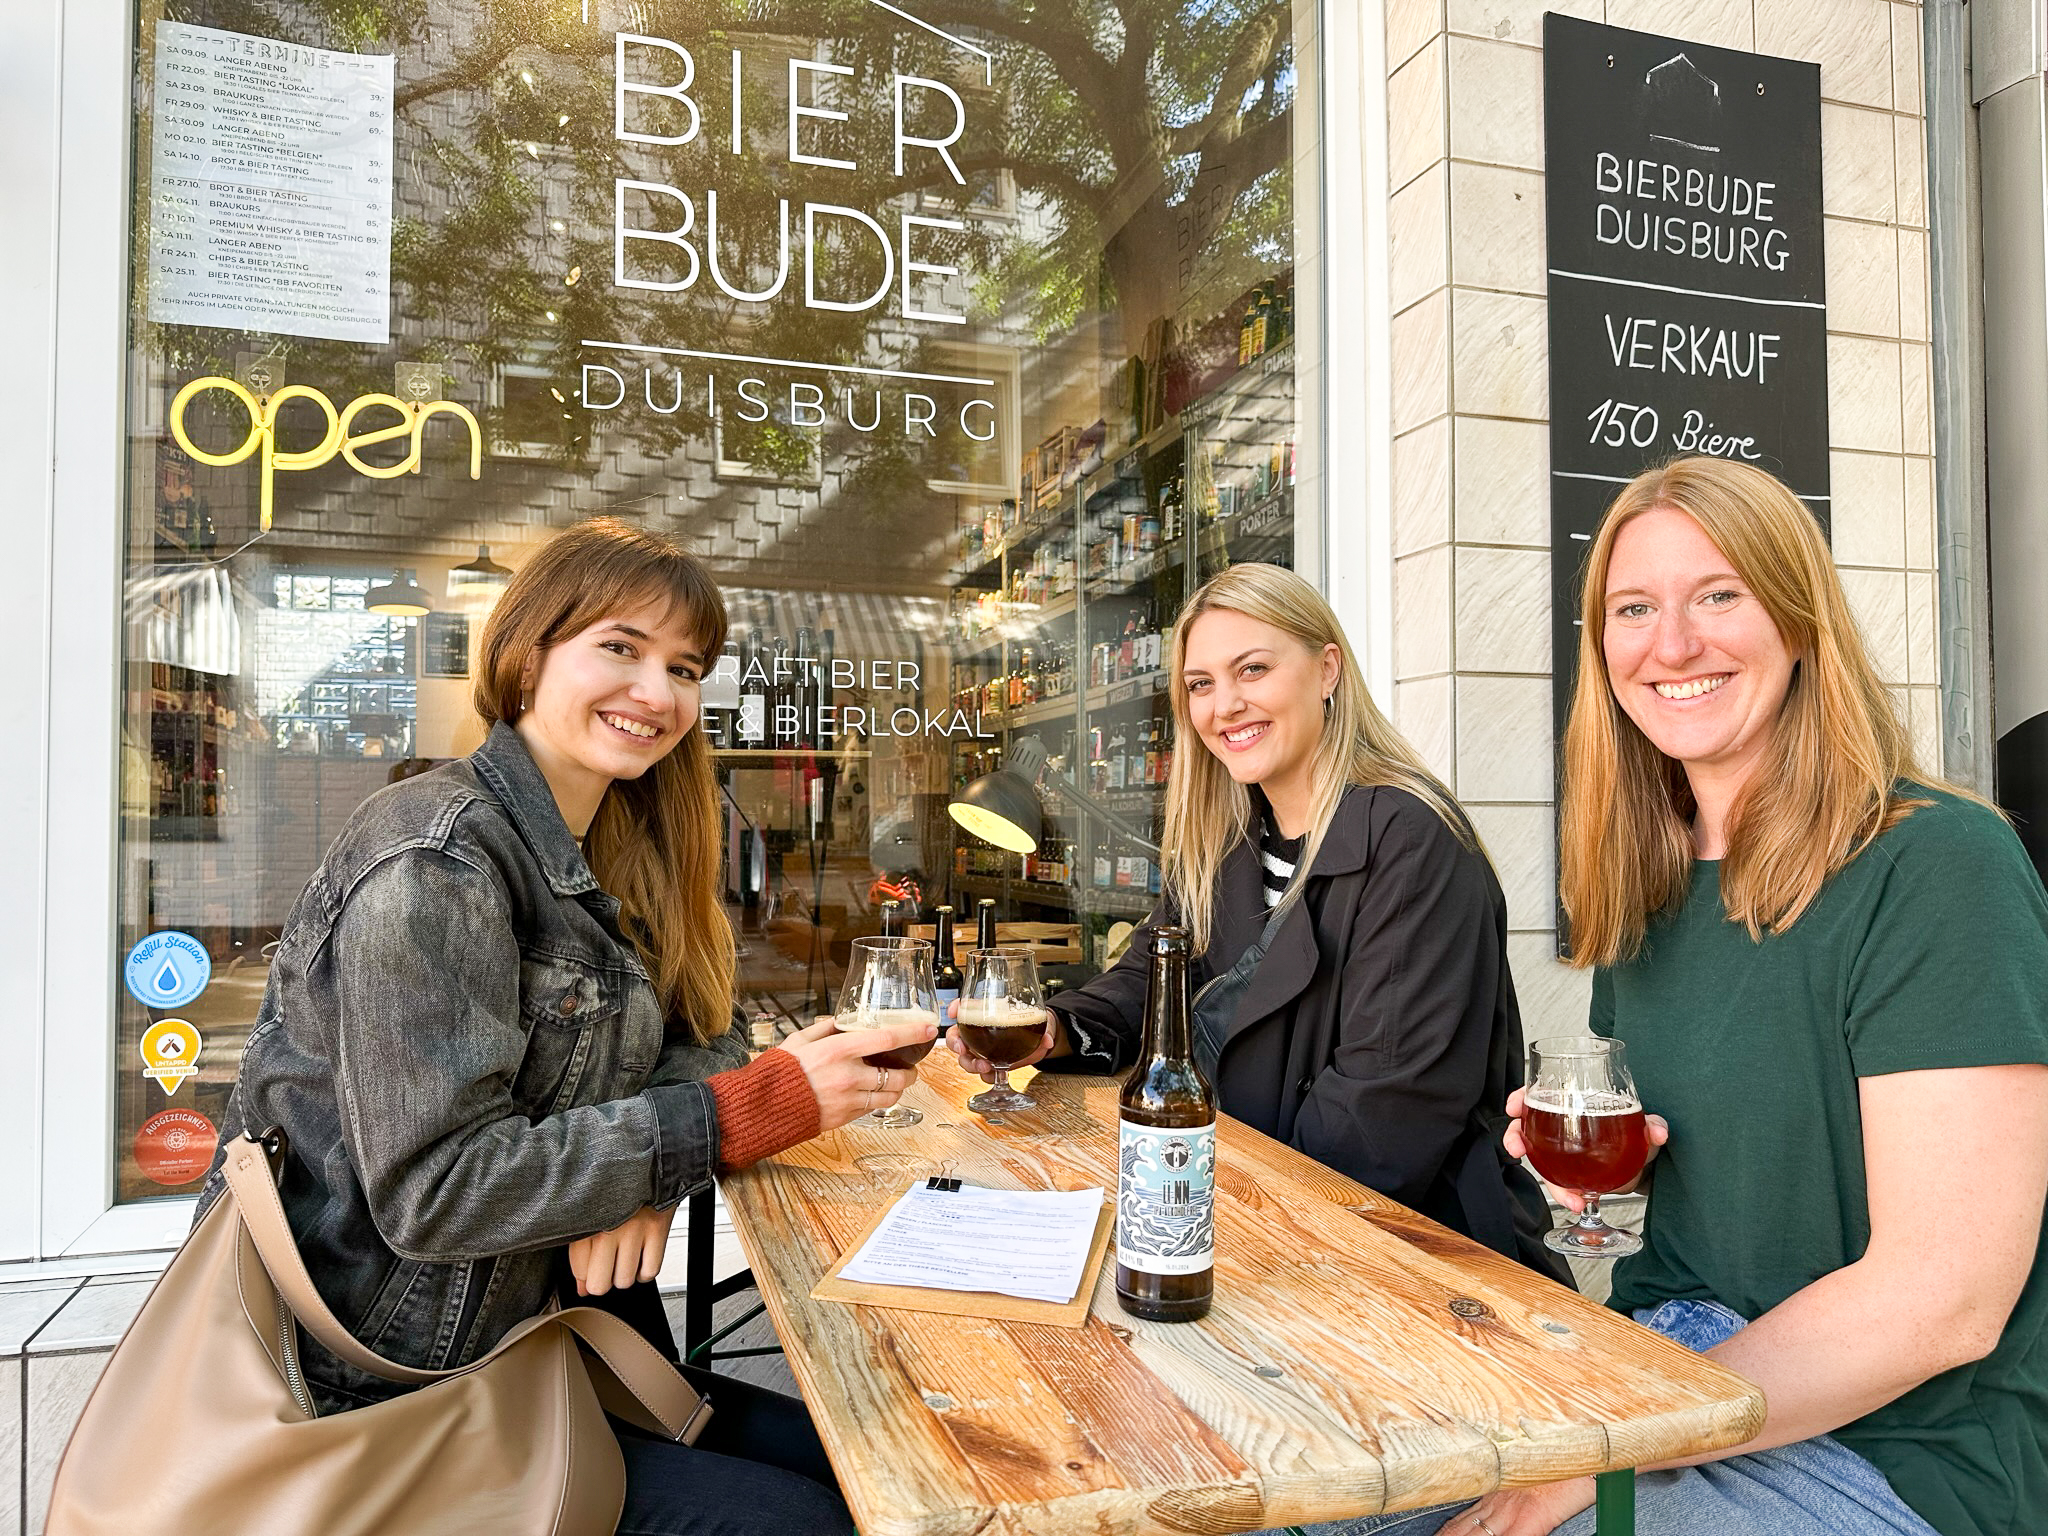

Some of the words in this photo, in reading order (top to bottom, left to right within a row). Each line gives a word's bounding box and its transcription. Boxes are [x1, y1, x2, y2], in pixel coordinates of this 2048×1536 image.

[166, 46, 179, 56] SA
[181, 48, 209, 61] 09.09.
[214, 54, 252, 68] LANGER
[254, 61, 287, 72] ABEND
[166, 63, 179, 73] FR
[181, 65, 208, 78] 22.09.
[214, 71, 236, 82] BIER
[238, 74, 276, 89] TASTING
[165, 80, 178, 90] SA
[180, 83, 207, 95] 23.09.
[213, 88, 265, 102] BRAUKURS
[165, 98, 178, 108] FR
[180, 101, 206, 113] 29.09.
[213, 106, 250, 120] WHISKY
[251, 112, 258, 121] &
[260, 114, 282, 123] BIER
[284, 116, 322, 127] TASTING
[615, 32, 966, 185] BIER
[164, 115, 178, 125] SA
[212, 124, 250, 137] LANGER
[252, 130, 285, 139] ABEND
[164, 133, 181, 143] MO
[183, 135, 207, 147] 02.10.
[212, 139, 233, 150] BIER
[236, 142, 274, 156] TASTING
[163, 150, 177, 159] SA
[178, 152, 202, 163] 14.10.
[211, 156, 237, 167] BROT
[239, 159, 245, 168] &
[247, 160, 269, 171] BIER
[271, 164, 309, 175] TASTING
[162, 177, 175, 187] FR
[177, 179, 201, 190] 27.10.
[209, 183, 235, 194] BROT
[237, 187, 244, 195] &
[246, 188, 268, 198] BIER
[270, 190, 308, 202] TASTING
[1596, 152, 1776, 221] BIERBUDE
[162, 195, 174, 205] SA
[209, 200, 261, 212] BRAUKURS
[161, 230, 174, 240] SA
[208, 237, 247, 249] LANGER
[248, 241, 282, 251] ABEND
[162, 212, 175, 222] FR
[209, 219, 254, 232] PREMIUM
[256, 225, 293, 236] WHISKY
[294, 229, 301, 237] &
[303, 229, 325, 240] BIER
[326, 232, 364, 243] TASTING
[1596, 204, 1790, 271] DUISBURG
[161, 248, 174, 258] FR
[176, 250, 198, 261] 24.11.
[208, 254, 237, 265] CHIPS
[239, 257, 245, 266] &
[247, 258, 269, 268] BIER
[271, 260, 309, 271] TASTING
[615, 179, 966, 325] BUDE
[160, 266, 174, 275] SA
[175, 267, 197, 278] 25.11.
[208, 271, 230, 281] BIER
[232, 274, 271, 285] TASTING
[292, 280, 343, 291] FAVORITEN
[157, 297, 180, 306] MEHR
[182, 300, 205, 308] INFOS
[217, 303, 243, 312] LADEN
[244, 306, 266, 314] ODER
[187, 291, 210, 300] AUCH
[211, 293, 242, 302] PRIVATE
[244, 296, 317, 309] VERANSTALTUNGEN
[1605, 314, 1780, 384] VERKAUF
[582, 365, 996, 441] DUISBURG
[1588, 398, 1658, 448] 150
[1672, 409, 1761, 459] Biere
[170, 376, 483, 532] open
[1240, 500, 1280, 537] PORTER
[699, 656, 818, 686] RAFT
[831, 658, 920, 691] BIER
[736, 704, 762, 735] &
[776, 705, 994, 738] BIERLOKAL
[132, 939, 162, 964] Refill
[165, 936, 204, 964] Station
